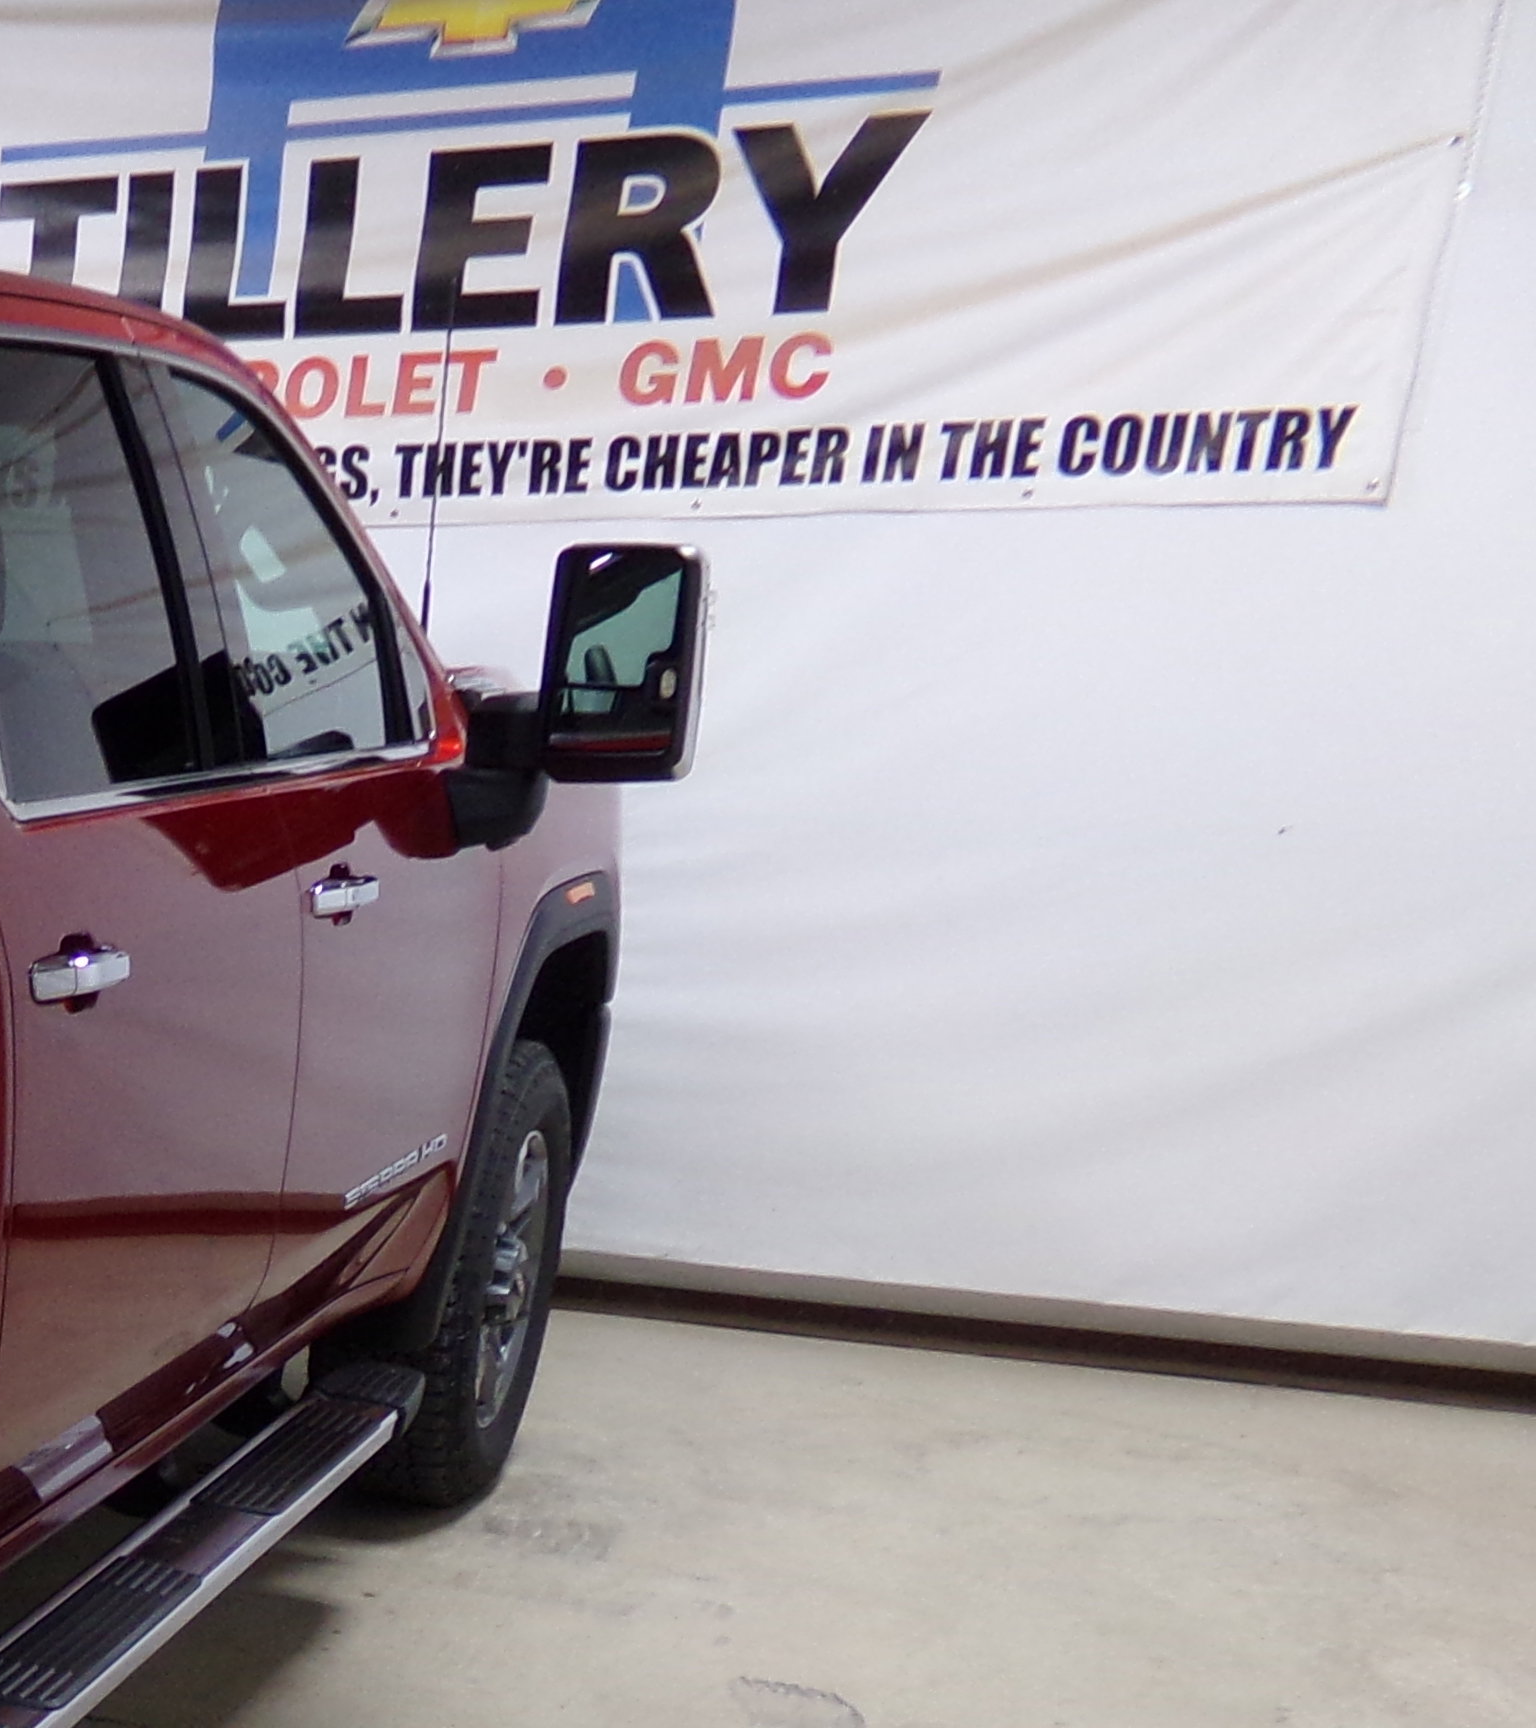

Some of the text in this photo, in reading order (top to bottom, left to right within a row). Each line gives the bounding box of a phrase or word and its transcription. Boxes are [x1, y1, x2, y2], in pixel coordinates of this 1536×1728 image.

[619, 332, 833, 406] GMC
[394, 437, 593, 499] THEY'RE
[605, 426, 850, 491] CHEAPER
[860, 421, 926, 484] IN
[939, 416, 1047, 482] THE
[1058, 404, 1359, 477] COUNTRY
[343, 1133, 448, 1210] SIERRA HD
